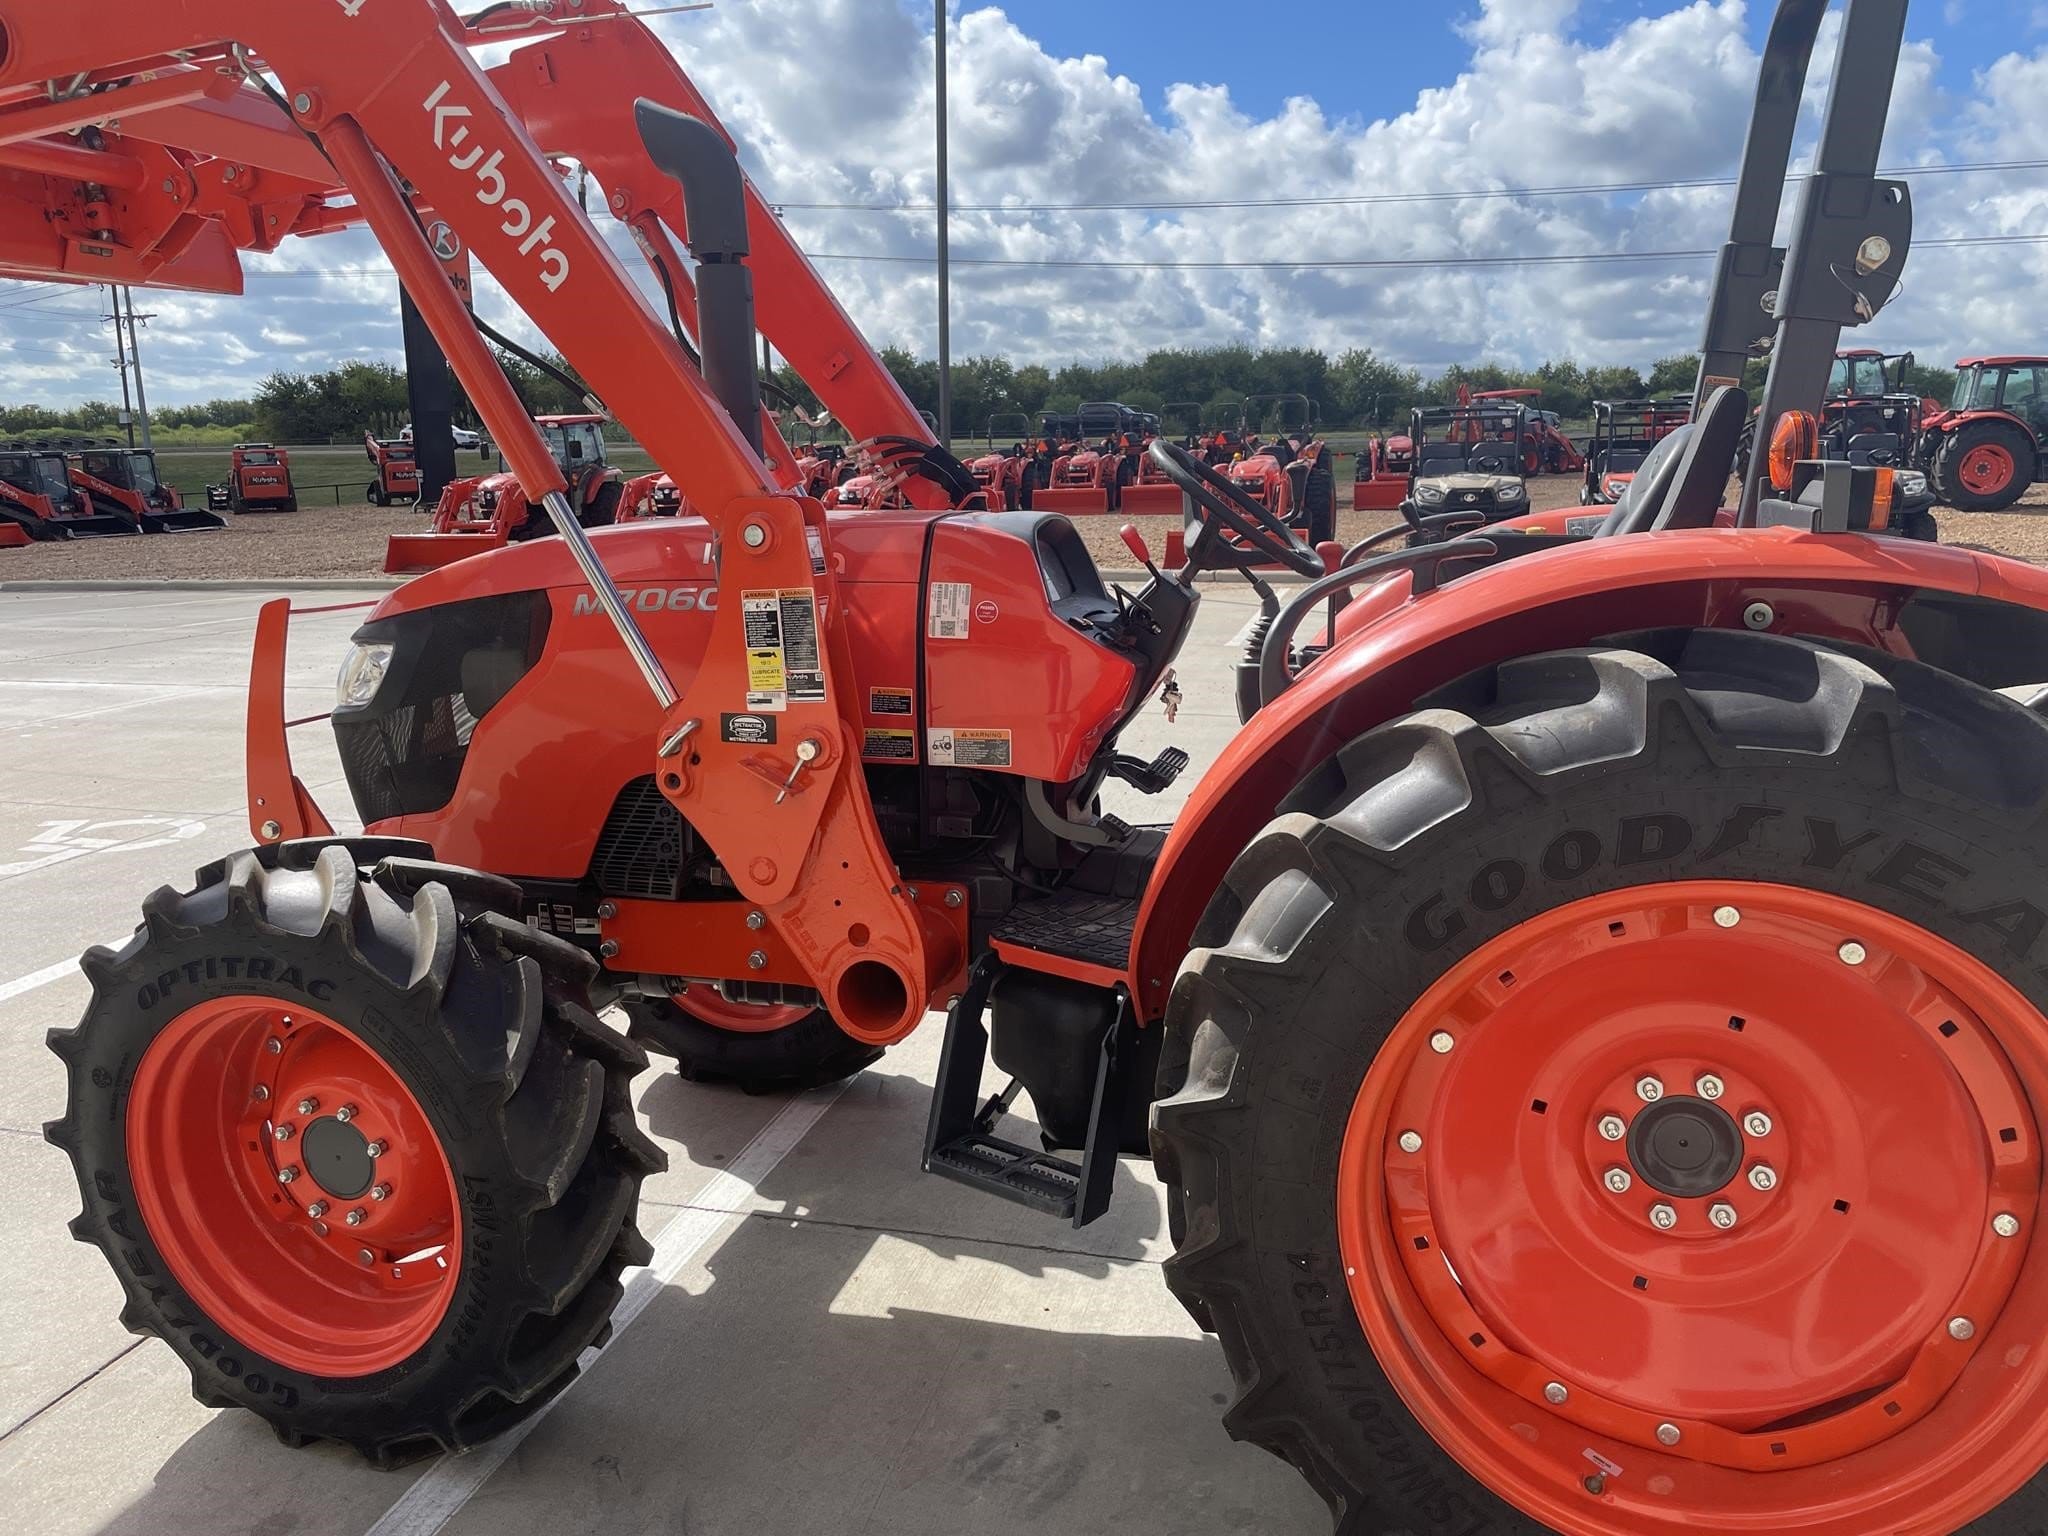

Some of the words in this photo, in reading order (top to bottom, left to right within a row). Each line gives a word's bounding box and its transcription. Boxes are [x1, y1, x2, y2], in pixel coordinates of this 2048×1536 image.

[423, 79, 569, 293] Kubota
[90, 478, 113, 496] Kubota
[252, 475, 278, 485] Kubota
[1404, 803, 2048, 976] GOODYEA
[138, 956, 337, 1011] OPTITRAC
[94, 1169, 300, 1409] GOODYEAR
